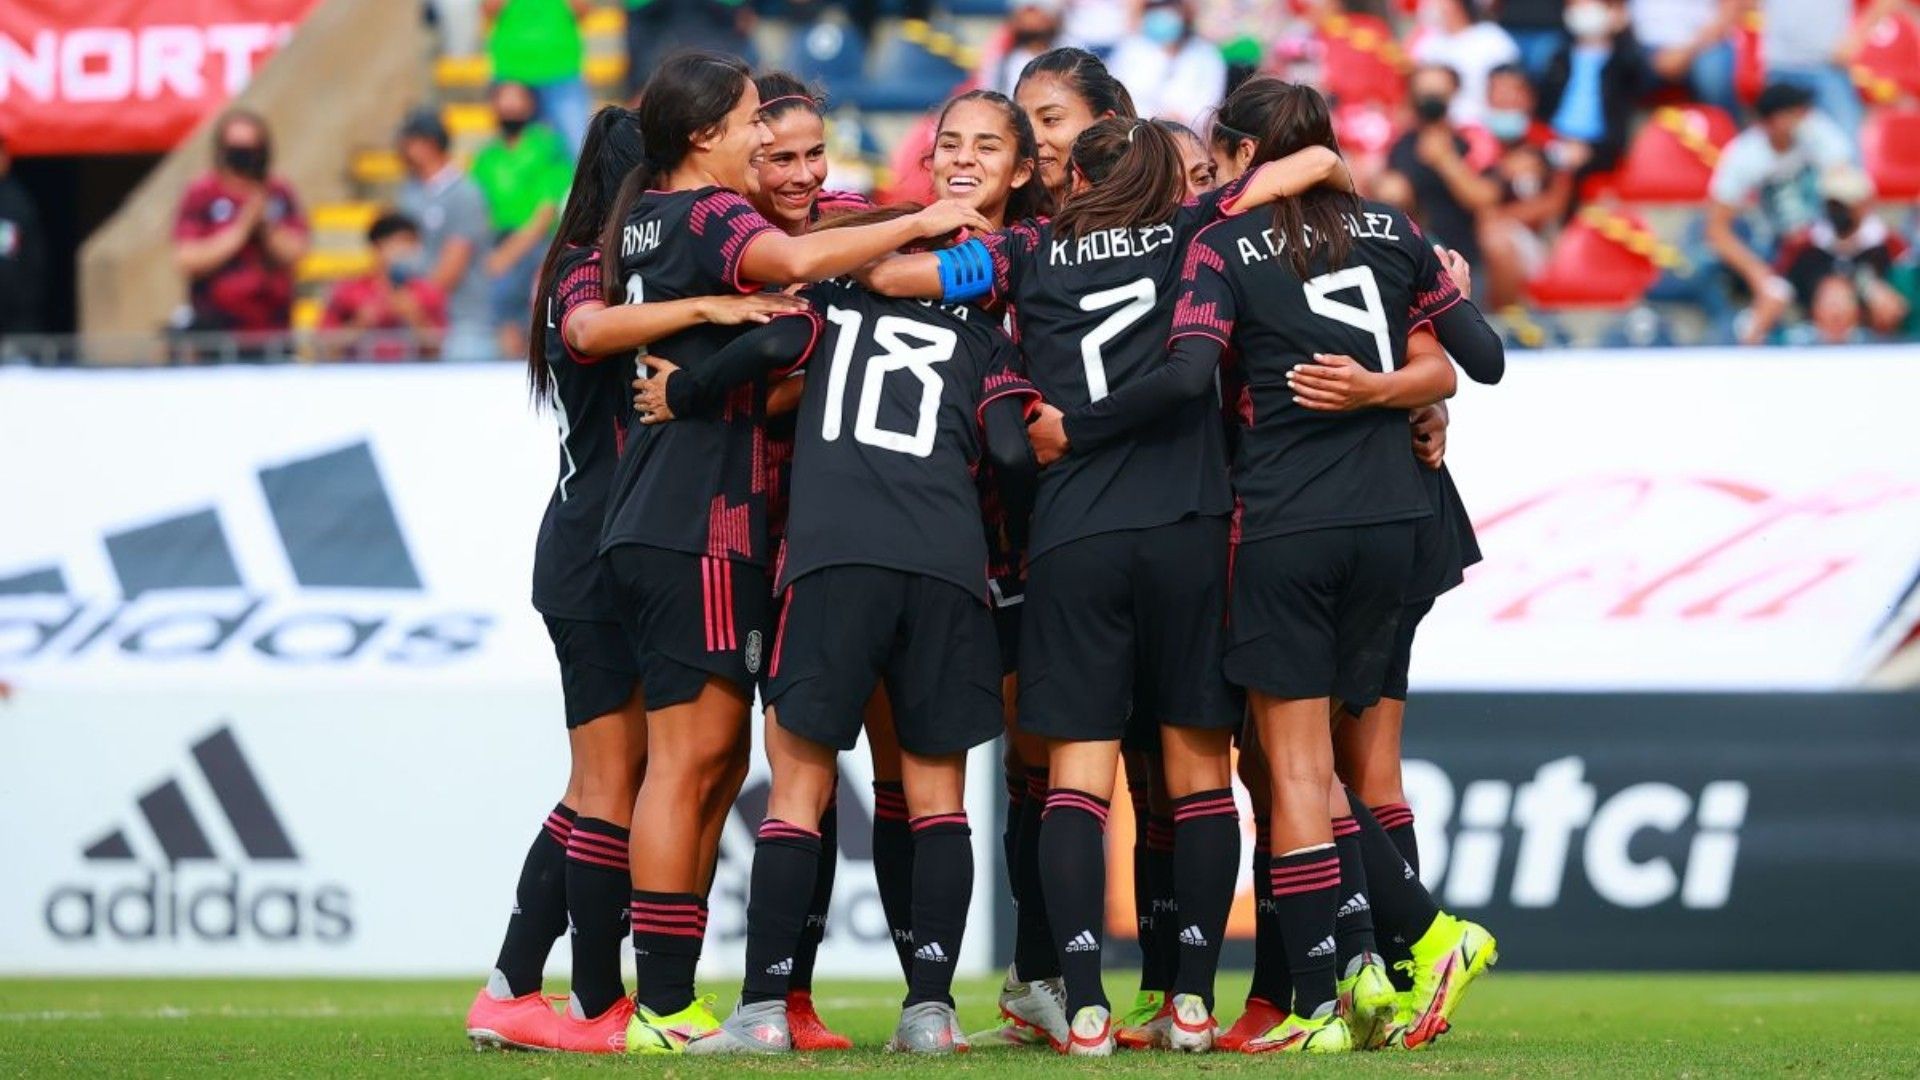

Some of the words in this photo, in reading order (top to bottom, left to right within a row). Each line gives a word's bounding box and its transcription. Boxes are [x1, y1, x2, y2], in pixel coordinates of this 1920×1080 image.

[1049, 222, 1174, 266] K.ROBLES
[1080, 276, 1158, 404] 7
[1303, 265, 1394, 374] 9
[822, 304, 957, 458] 18
[1400, 755, 1749, 909] Bitci
[45, 866, 355, 943] adidas
